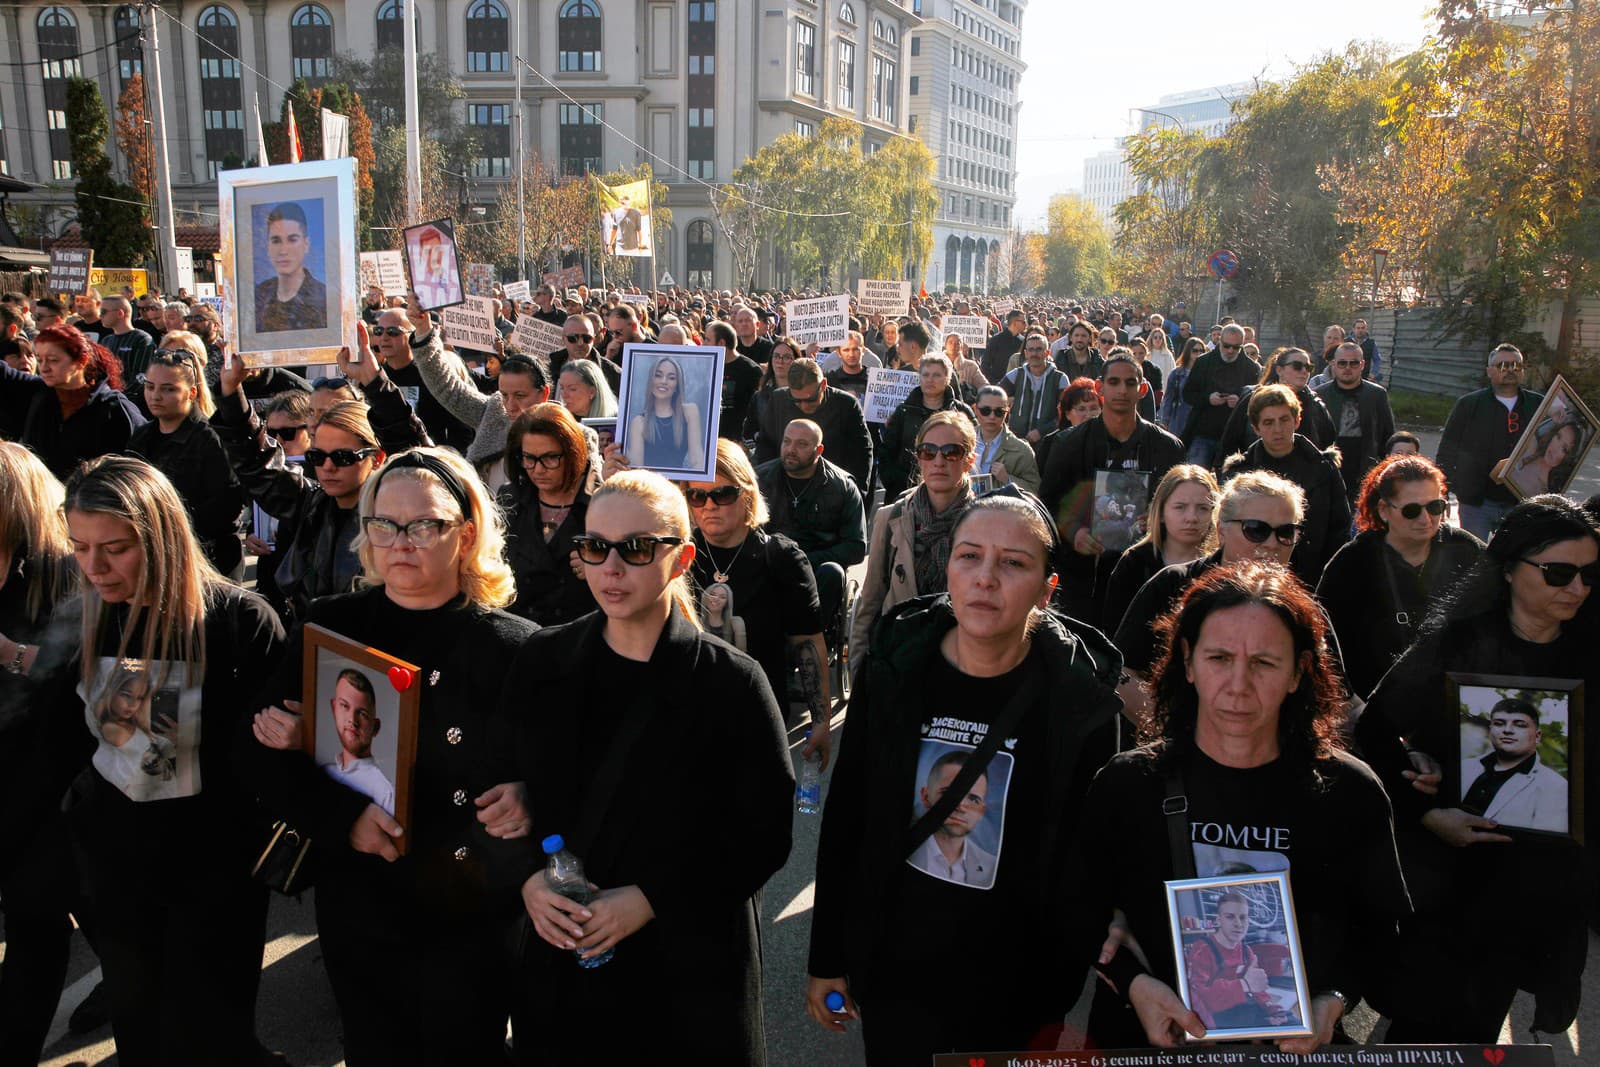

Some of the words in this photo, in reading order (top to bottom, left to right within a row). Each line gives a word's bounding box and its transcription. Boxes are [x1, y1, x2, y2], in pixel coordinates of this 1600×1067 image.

[91, 272, 108, 285] City
[112, 272, 138, 282] House
[469, 299, 473, 311] НЕ
[809, 302, 819, 316] ДЕТЕ
[820, 301, 825, 312] НЕ
[826, 300, 839, 312] УМРЕ,
[446, 310, 456, 323] БЕШЕ
[456, 312, 469, 326] УБИЕНО
[470, 314, 474, 328] ОД
[475, 316, 490, 329] СИСТЕМ
[790, 320, 801, 331] БЕШЕ
[802, 317, 819, 329] УБИЕНО
[820, 316, 825, 329] ОД
[827, 314, 843, 326] СИСТЕМ
[480, 333, 493, 346] УБИВА
[819, 330, 830, 342] ТУКУ
[831, 329, 844, 341] УБИВА
[877, 372, 882, 381] 62
[883, 372, 901, 382] ЖИВОТИ
[904, 375, 909, 384] 62
[868, 384, 874, 392] 62
[874, 384, 896, 395] СЕМЕЈСТВА
[897, 386, 903, 396] СО
[873, 396, 890, 407] ПРАВДА
[931, 717, 989, 734] ЗАСЕКОГАШ
[928, 727, 970, 743] НАШИТЕ
[1190, 822, 1290, 849] ТОМЧЕ
[1091, 1056, 1107, 1067] 63
[1110, 1056, 1153, 1066] сенки
[1158, 1050, 1173, 1065] ќе
[1177, 1054, 1193, 1064] ве
[1197, 1053, 1246, 1064] следат
[1260, 1053, 1299, 1065] секој
[1303, 1053, 1354, 1064] поглед
[1357, 1050, 1392, 1066] бара
[1397, 1050, 1464, 1065] ПРАВДА
